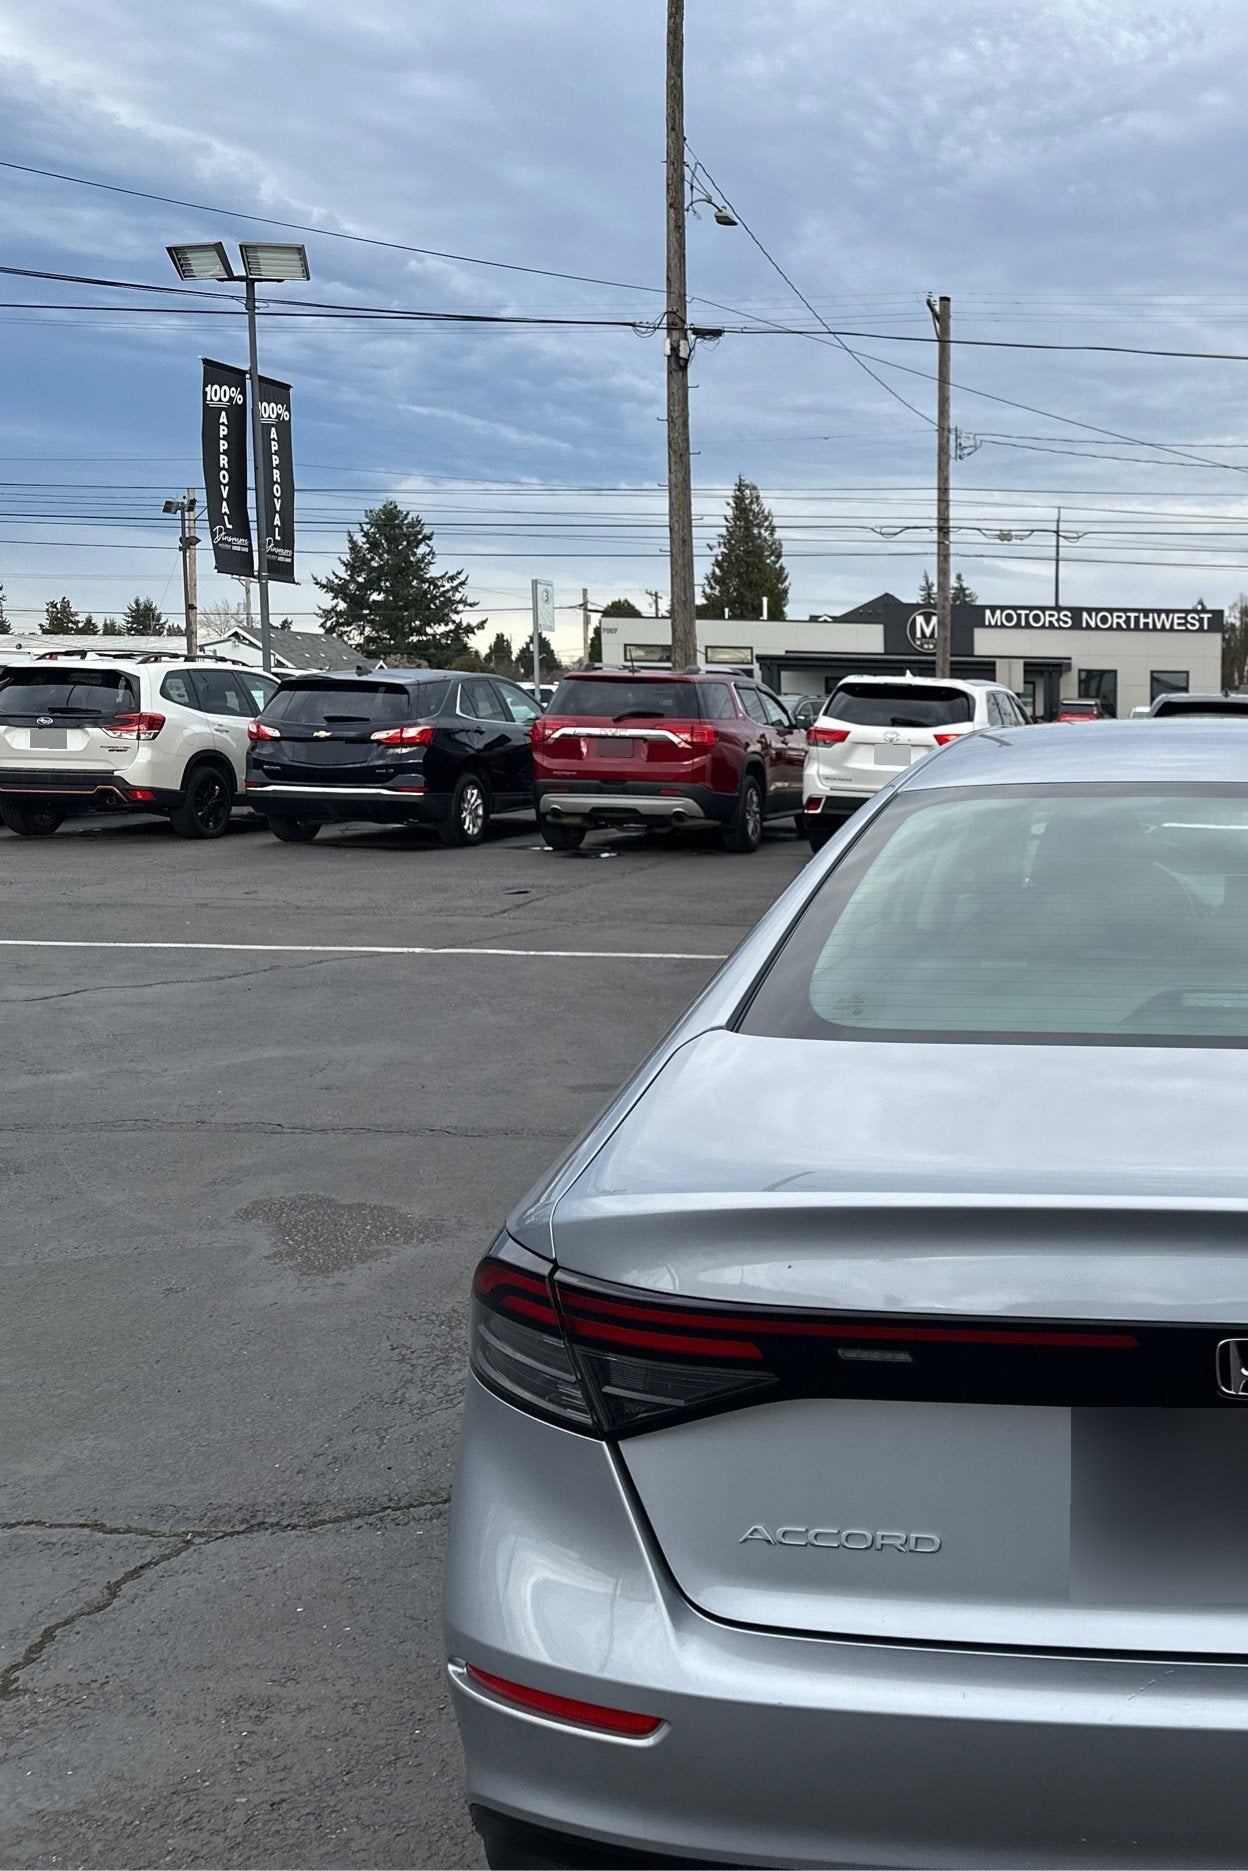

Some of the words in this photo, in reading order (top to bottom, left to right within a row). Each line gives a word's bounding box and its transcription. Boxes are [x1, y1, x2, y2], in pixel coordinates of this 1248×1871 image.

[205, 384, 243, 405] 100%
[219, 410, 233, 529] APPROVAL
[270, 427, 281, 540] APPROVAL
[915, 615, 938, 638] M
[984, 609, 1073, 628] MOTORS
[1082, 612, 1212, 630] NORTHWEST
[738, 1525, 941, 1553] ACCORD
